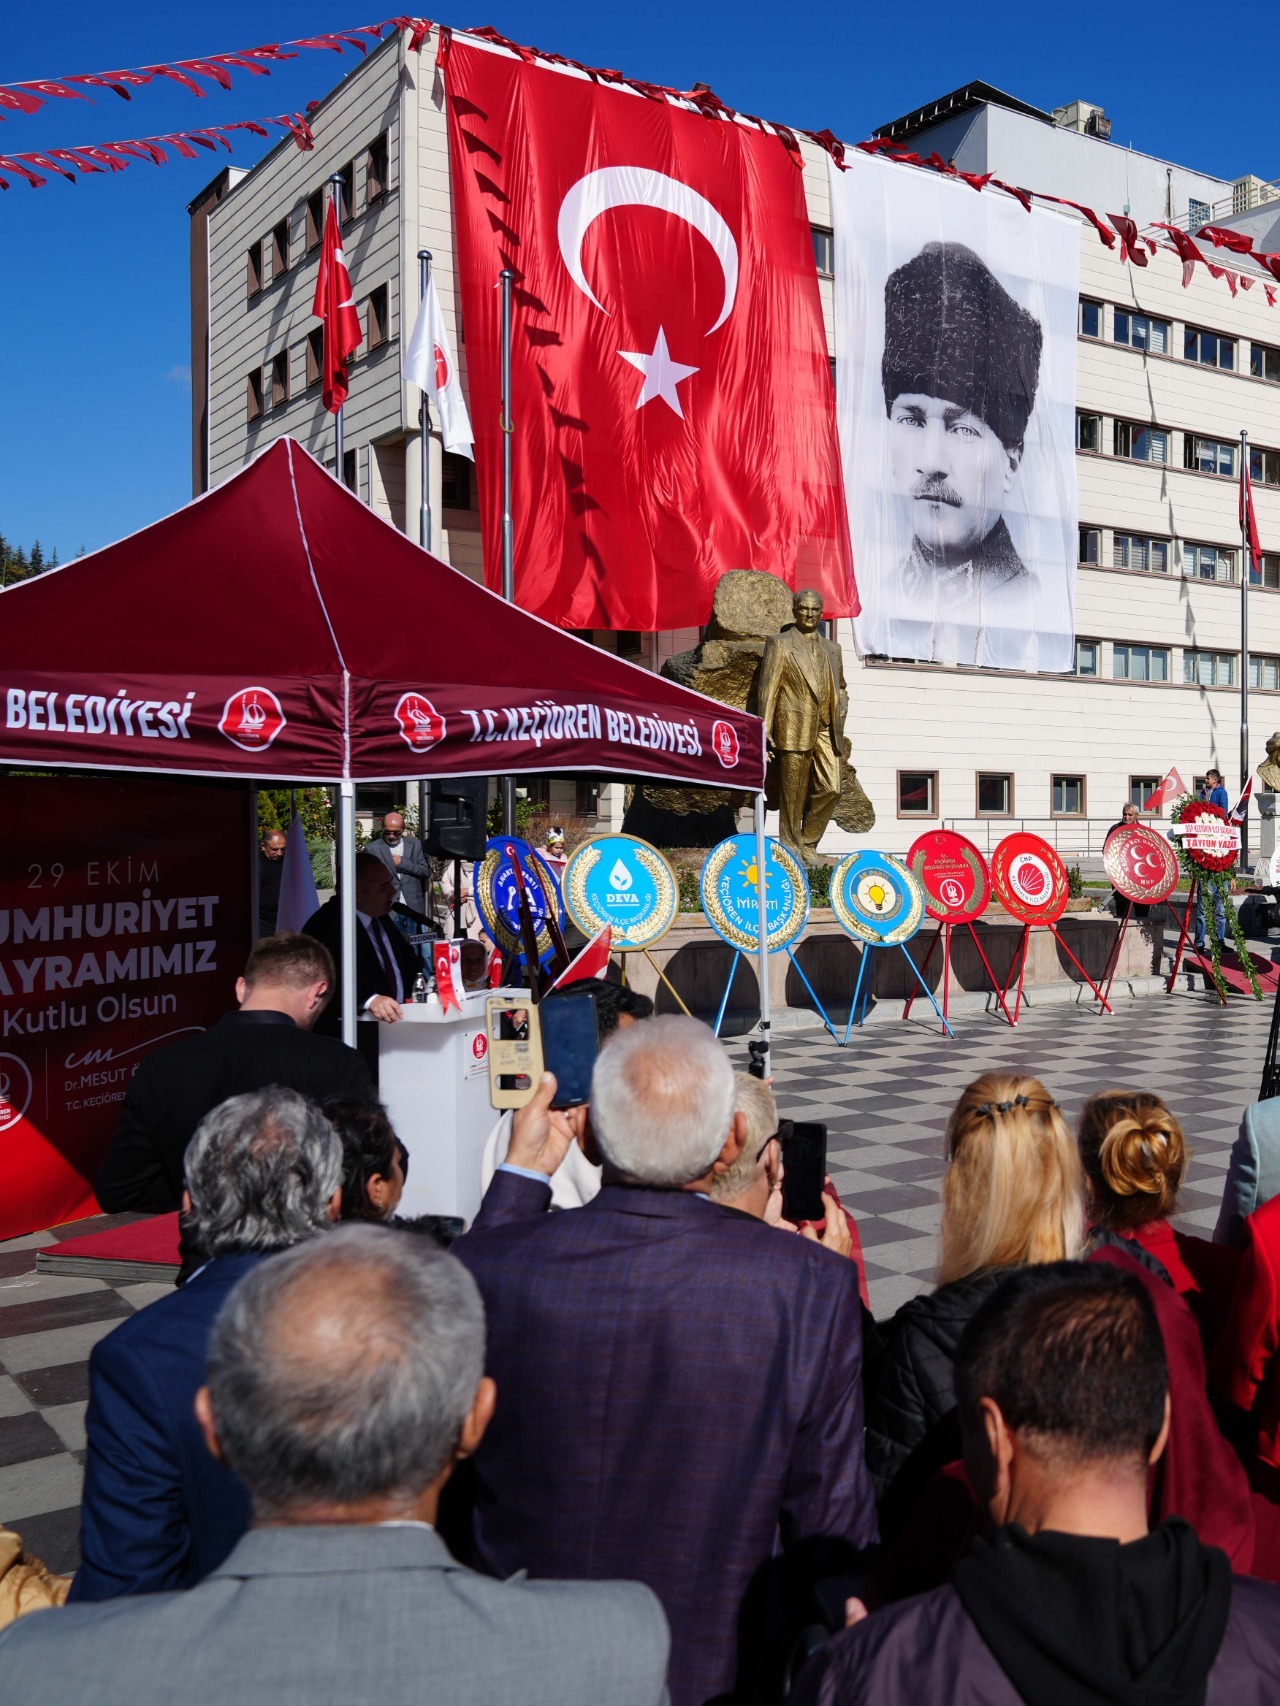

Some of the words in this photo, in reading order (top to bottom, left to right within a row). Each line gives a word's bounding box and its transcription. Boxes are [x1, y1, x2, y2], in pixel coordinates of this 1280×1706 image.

[6, 688, 196, 739] BELEDİYESİ
[605, 702, 703, 757] BELEDİYESİ
[1186, 839, 1216, 848] TAYFUN
[27, 863, 64, 888] 29
[88, 856, 159, 885] EKİM
[606, 893, 639, 902] DEVA
[745, 920, 759, 934] İLÇ
[767, 878, 792, 931] BAŞKANLIĞI
[751, 899, 778, 910] PRTİ
[3, 1001, 87, 1037] Kutlu
[97, 993, 177, 1022] Olsun
[65, 1101, 82, 1112] T.C.
